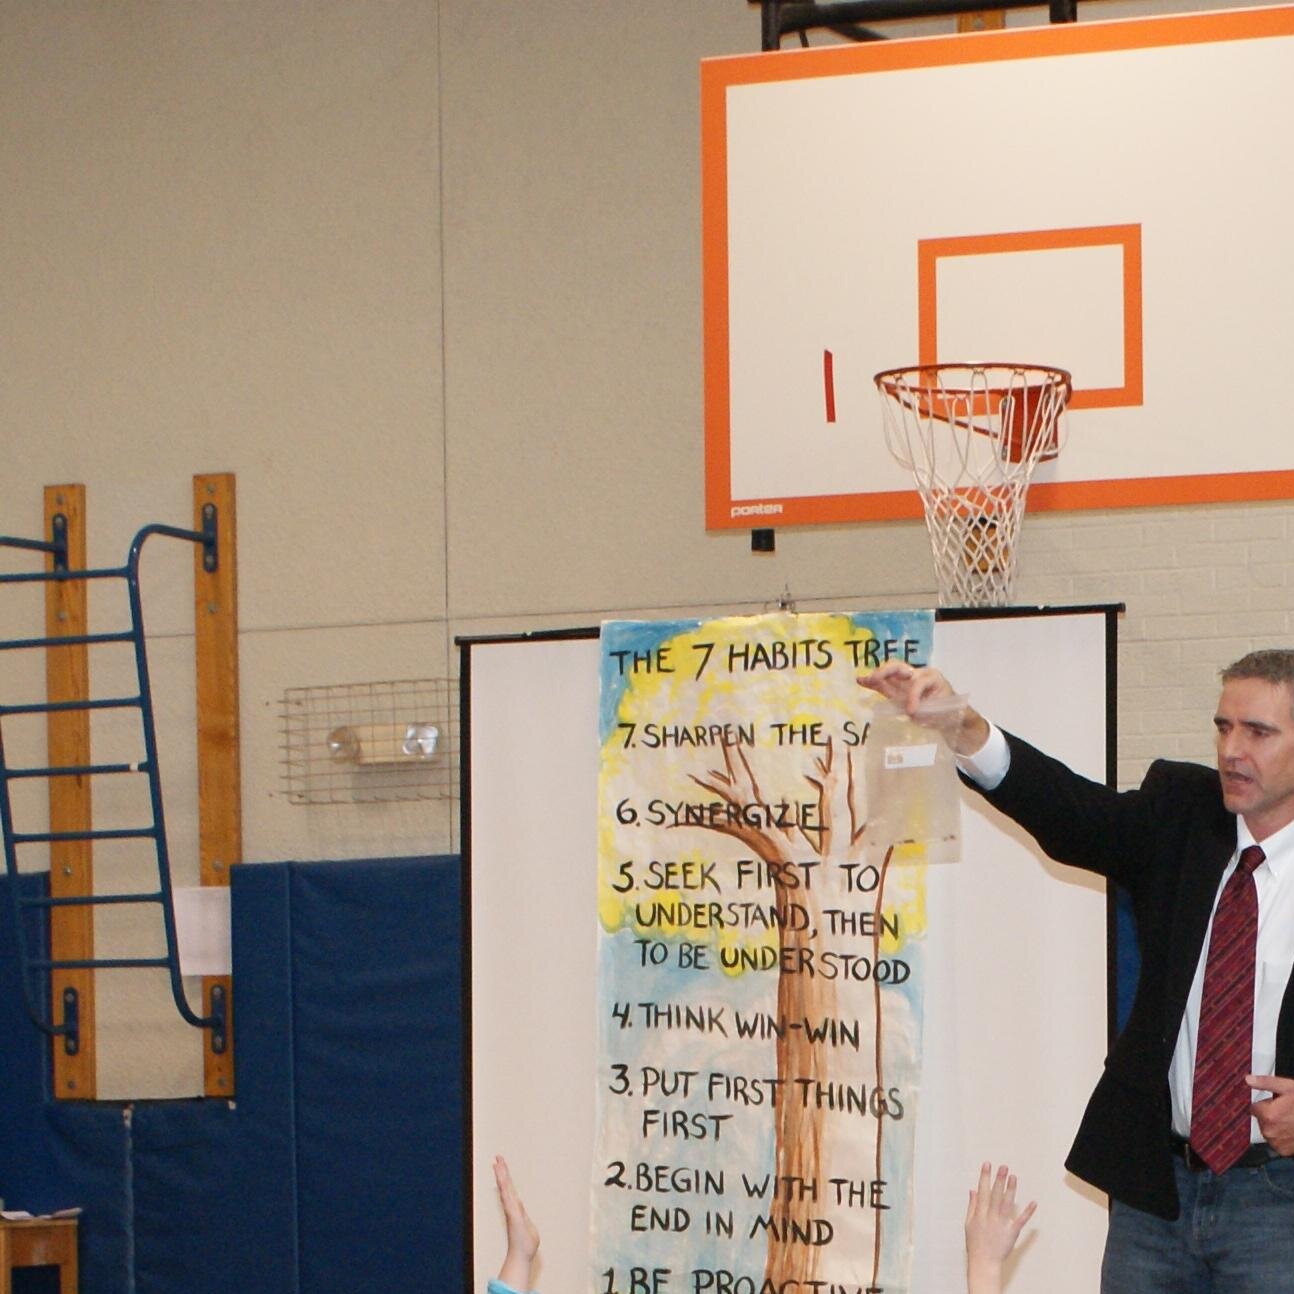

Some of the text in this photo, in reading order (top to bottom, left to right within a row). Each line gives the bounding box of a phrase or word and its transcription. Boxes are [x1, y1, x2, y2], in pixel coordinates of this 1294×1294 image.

[610, 639, 926, 680] THE 7 HABITS TREE
[770, 723, 832, 746] THE
[736, 860, 820, 890] FIRST
[838, 864, 880, 893] TO
[635, 903, 899, 940] UNDERSTAND, THEN
[634, 940, 911, 985] TO BE UNDERSTOOD
[735, 1013, 861, 1052] WIN-WIN
[708, 1073, 785, 1109] FIRST
[793, 1078, 905, 1121] THINGS
[641, 1110, 734, 1142] FIRST
[742, 1173, 819, 1204] WITH
[828, 1179, 892, 1210] THE
[630, 1205, 834, 1247] END IN MIND
